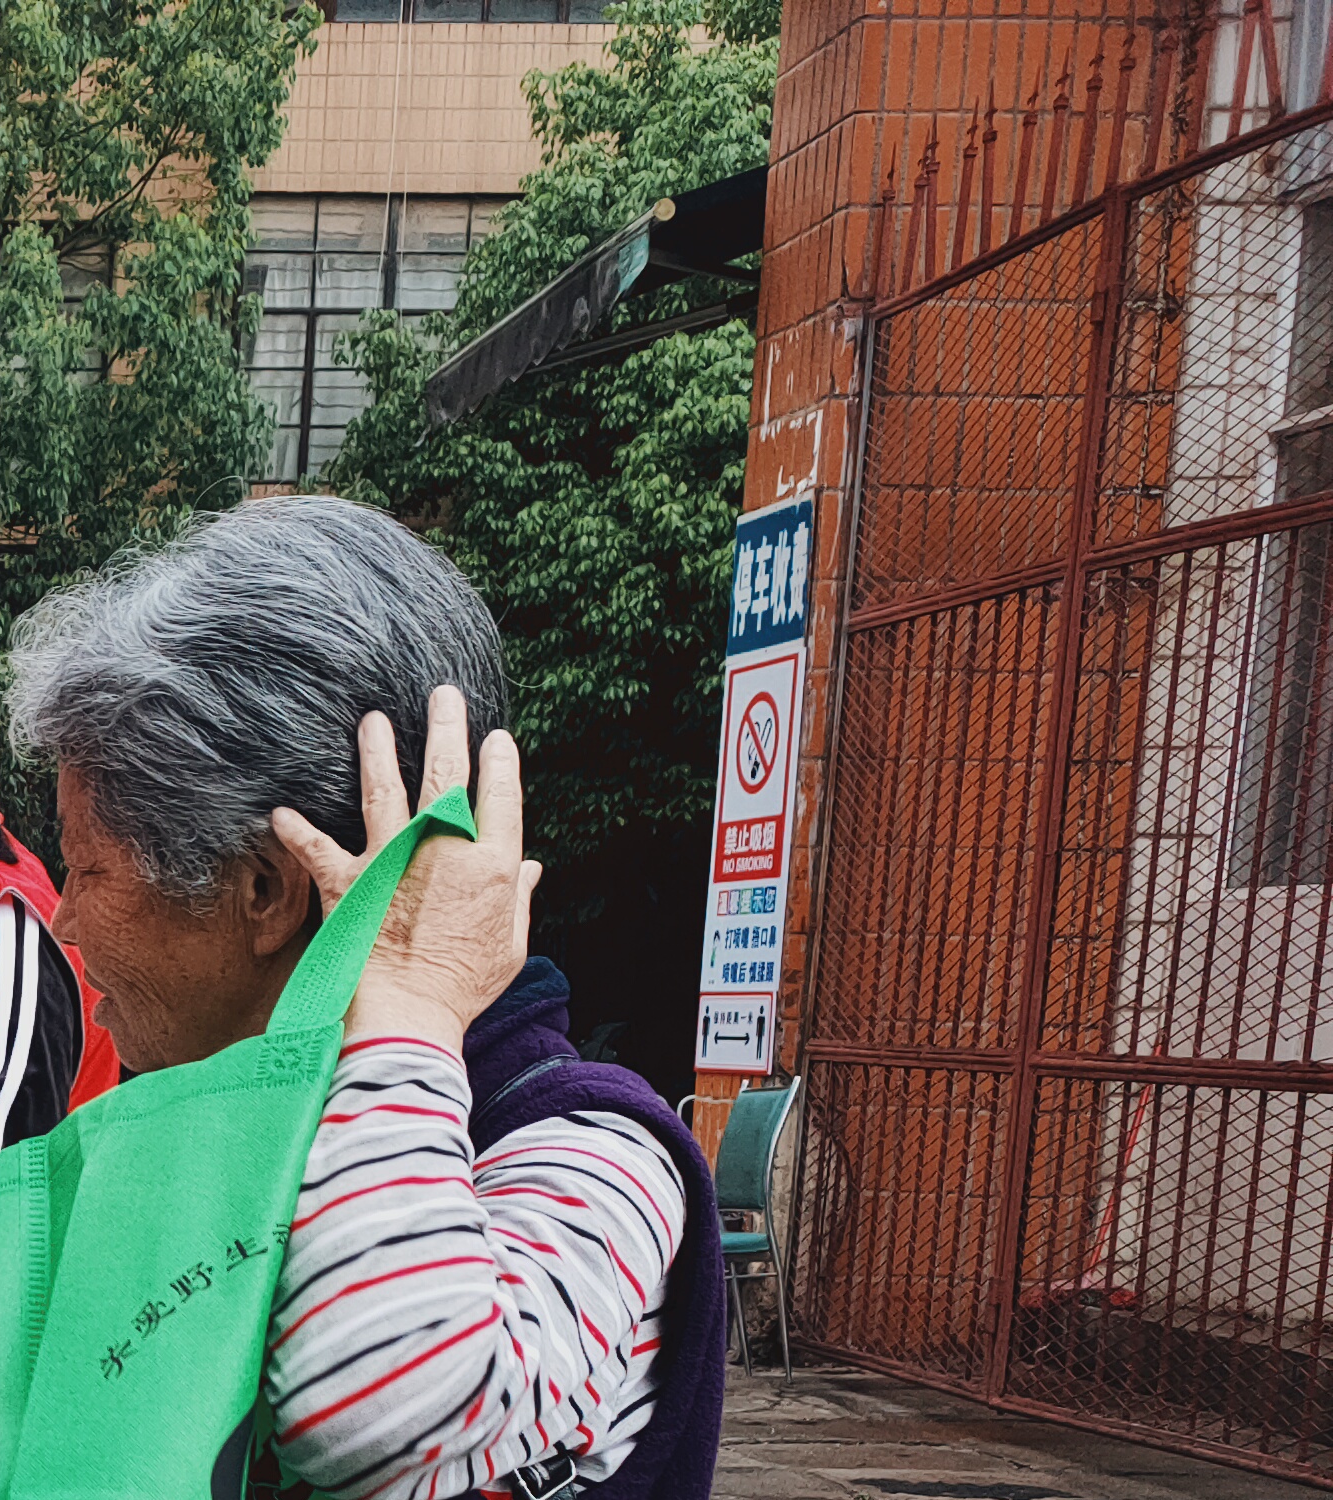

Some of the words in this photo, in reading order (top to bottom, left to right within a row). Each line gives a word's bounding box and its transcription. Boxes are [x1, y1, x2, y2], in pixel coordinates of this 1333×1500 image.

[732, 521, 809, 638] 停车收费
[724, 820, 777, 855] 禁止吸烟
[722, 858, 735, 873] NO
[735, 854, 774, 872] SMOKING
